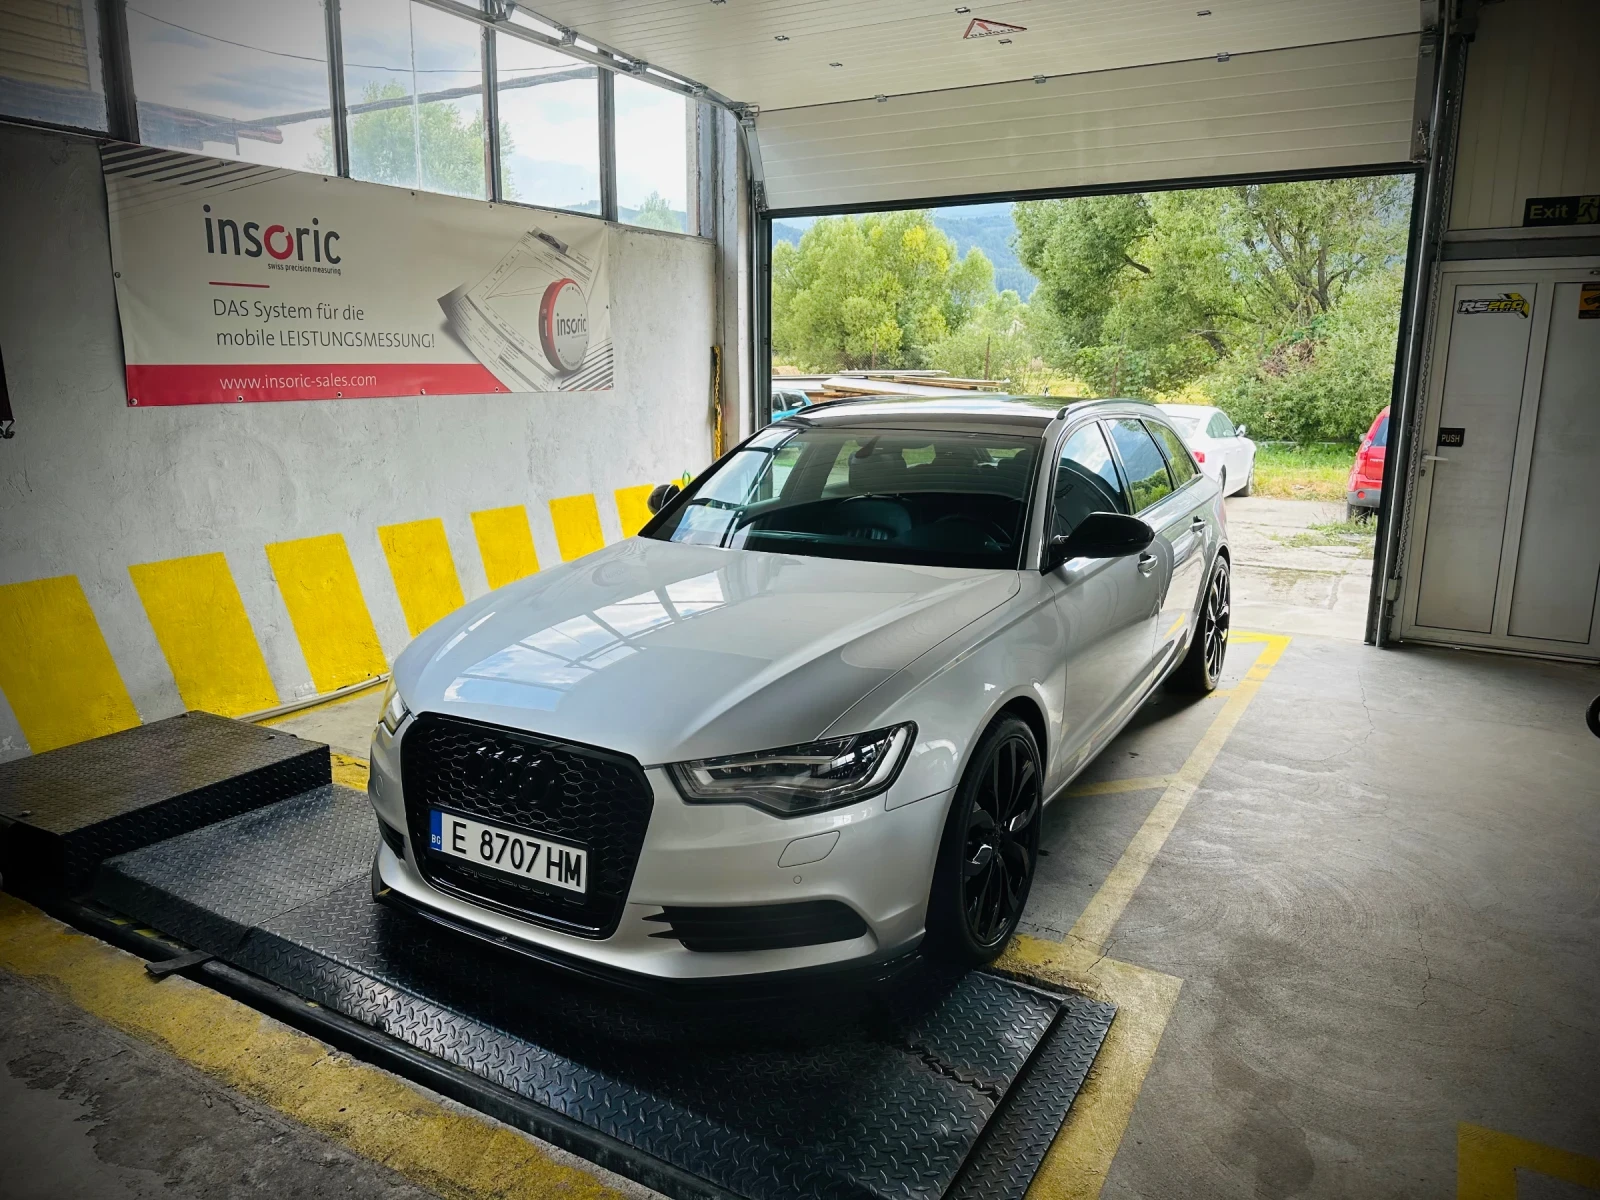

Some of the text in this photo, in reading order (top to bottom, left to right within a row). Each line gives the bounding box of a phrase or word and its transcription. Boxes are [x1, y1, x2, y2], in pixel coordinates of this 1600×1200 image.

[970, 29, 1014, 38] DANGER
[1530, 204, 1569, 219] Exit
[203, 204, 342, 265] insoric
[267, 262, 342, 276] swiss precision measuring
[213, 298, 364, 323] DAS System für die
[556, 312, 587, 337] insoric
[216, 329, 435, 348] mobile LEISTUNGSMESSUNG!
[219, 373, 377, 390] www.insoric-sales.com
[1441, 434, 1461, 443] PUSH
[431, 834, 441, 844] BG
[452, 820, 467, 854] E
[480, 829, 541, 873] 8707
[546, 846, 581, 887] HM
